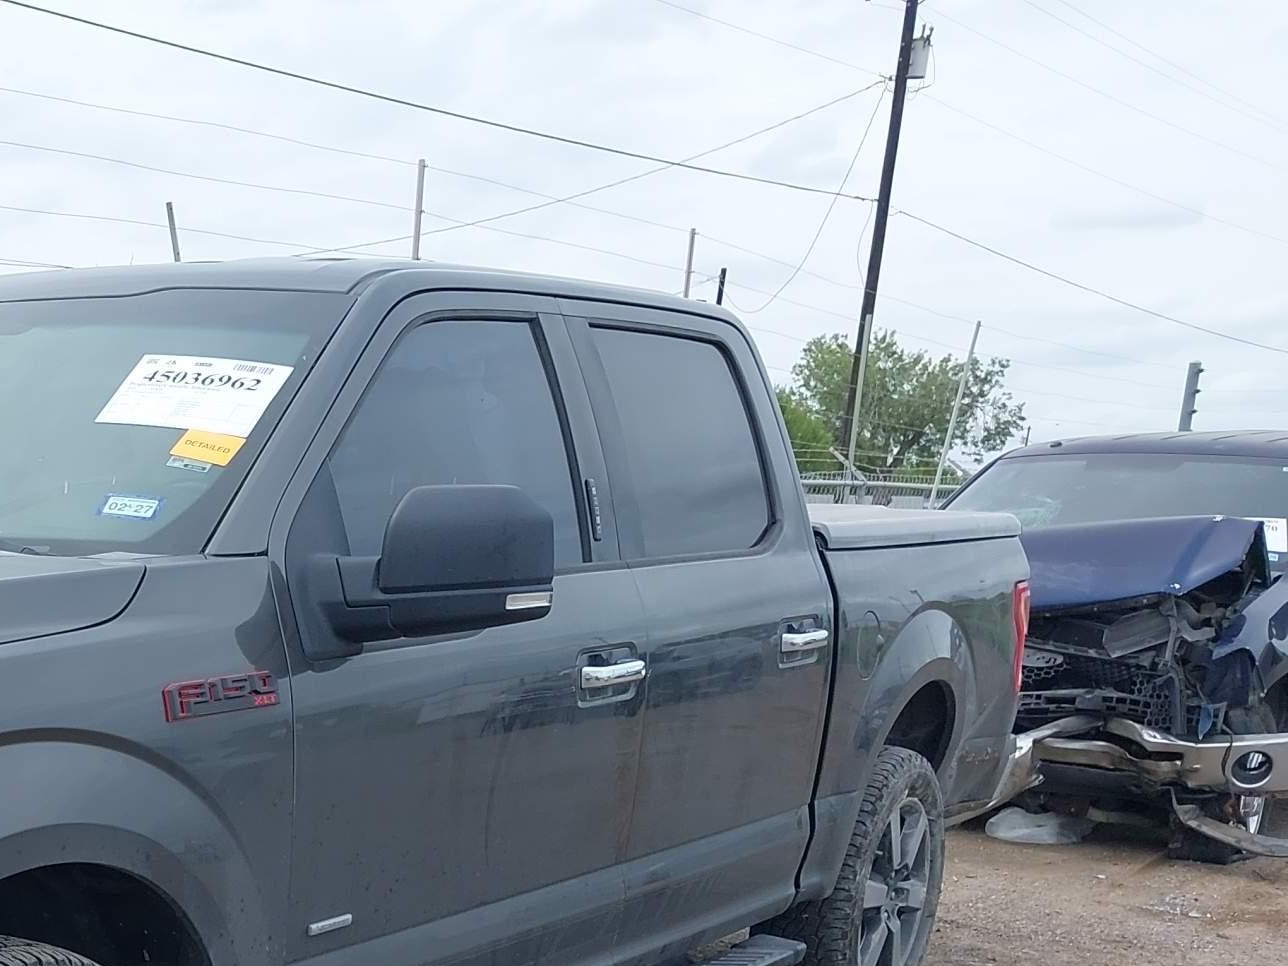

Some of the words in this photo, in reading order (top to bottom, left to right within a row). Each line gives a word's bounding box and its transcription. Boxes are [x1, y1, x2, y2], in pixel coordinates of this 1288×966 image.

[143, 369, 262, 391] 45036962
[184, 439, 231, 455] DETAILED
[108, 502, 127, 512] 02
[133, 504, 154, 514] 27
[254, 693, 278, 706] XLT
